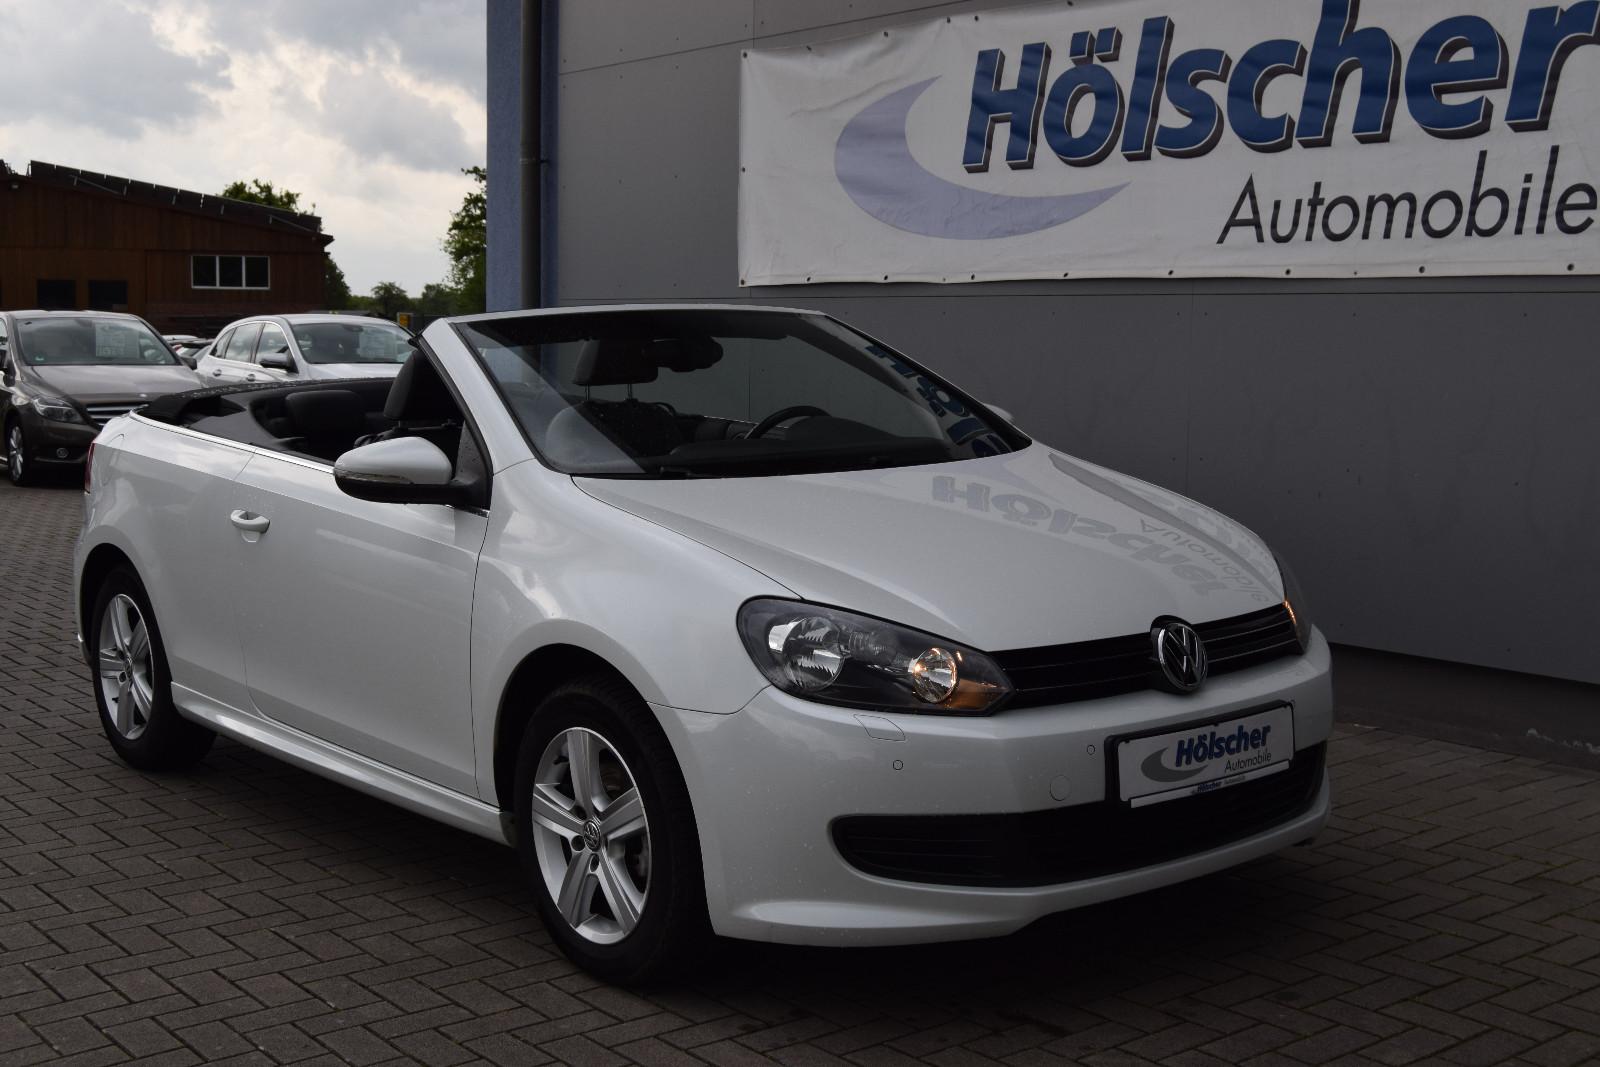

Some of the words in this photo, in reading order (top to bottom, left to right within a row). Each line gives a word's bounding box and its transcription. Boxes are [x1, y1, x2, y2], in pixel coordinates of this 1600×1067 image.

[962, 0, 1600, 174] Hölscher
[1216, 145, 1598, 245] Automobile
[1175, 725, 1271, 768] Hölscher
[1224, 748, 1272, 773] Automobile
